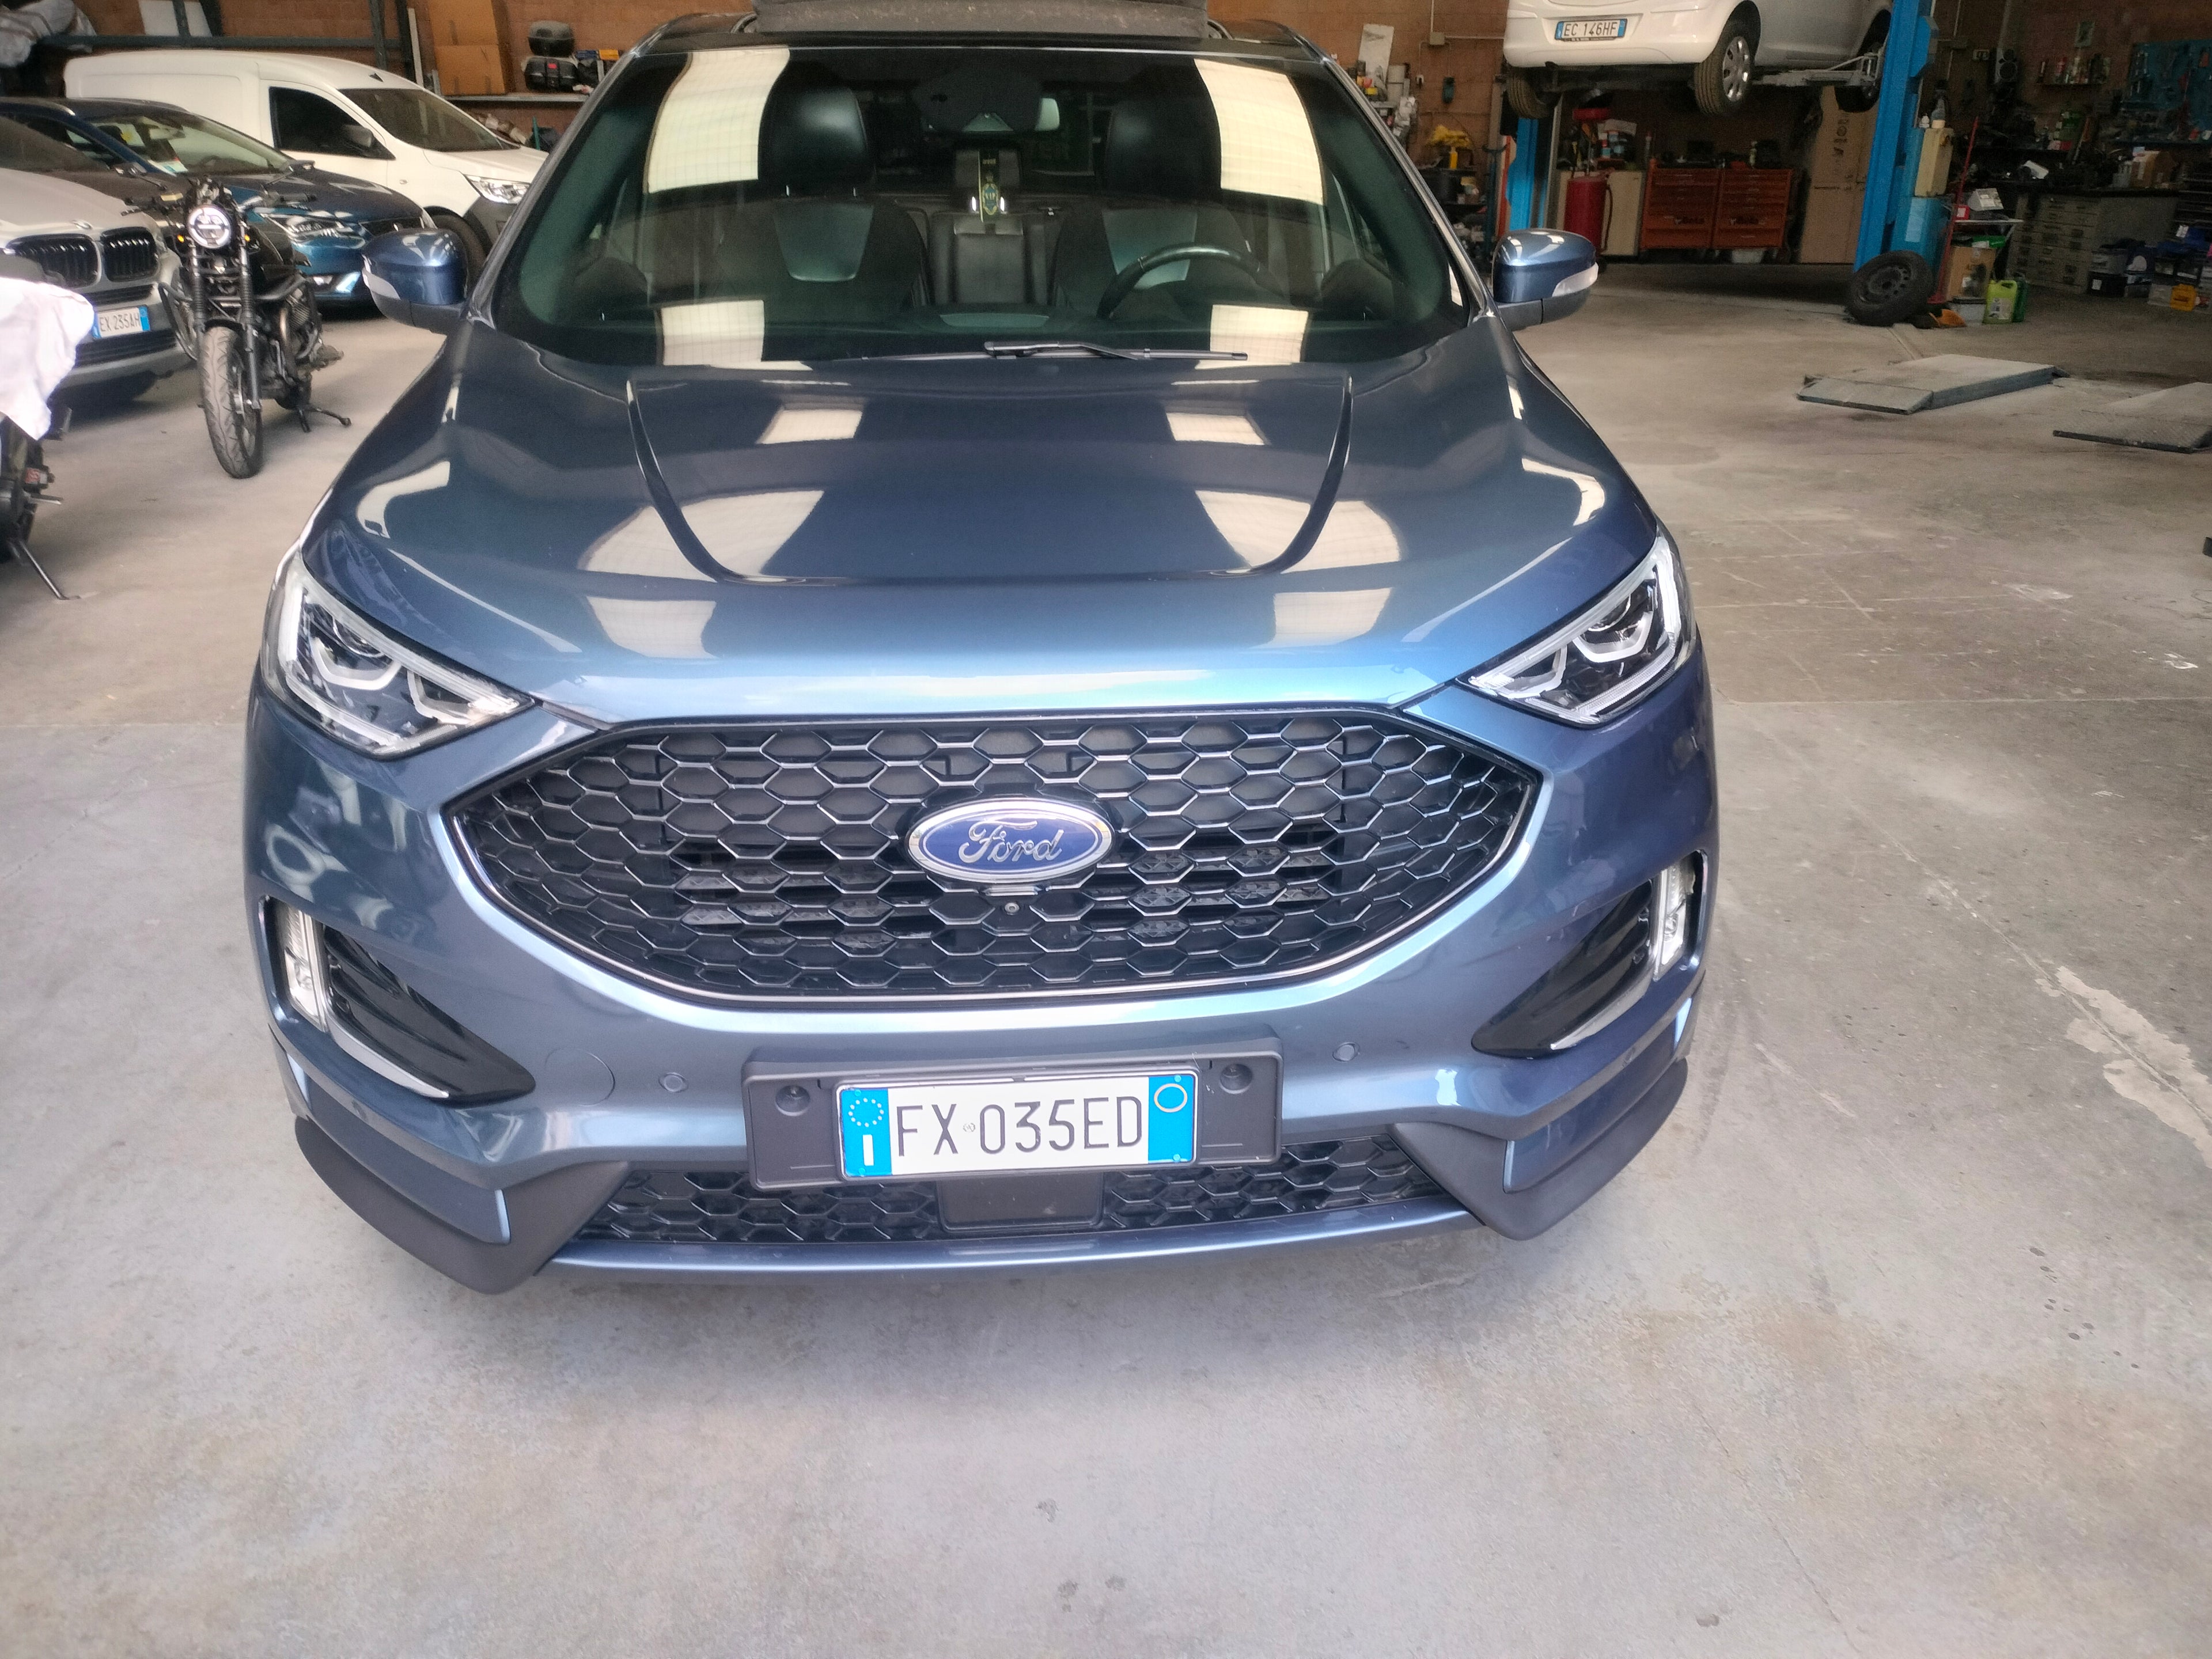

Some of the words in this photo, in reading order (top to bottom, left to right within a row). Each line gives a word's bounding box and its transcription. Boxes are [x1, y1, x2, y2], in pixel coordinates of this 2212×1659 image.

[1563, 23, 1578, 36] EC
[1584, 21, 1618, 36] 146HF
[99, 316, 112, 332] EX
[958, 818, 1065, 863] Ford
[896, 1103, 959, 1157] FX
[979, 1096, 1142, 1154] 035ED
